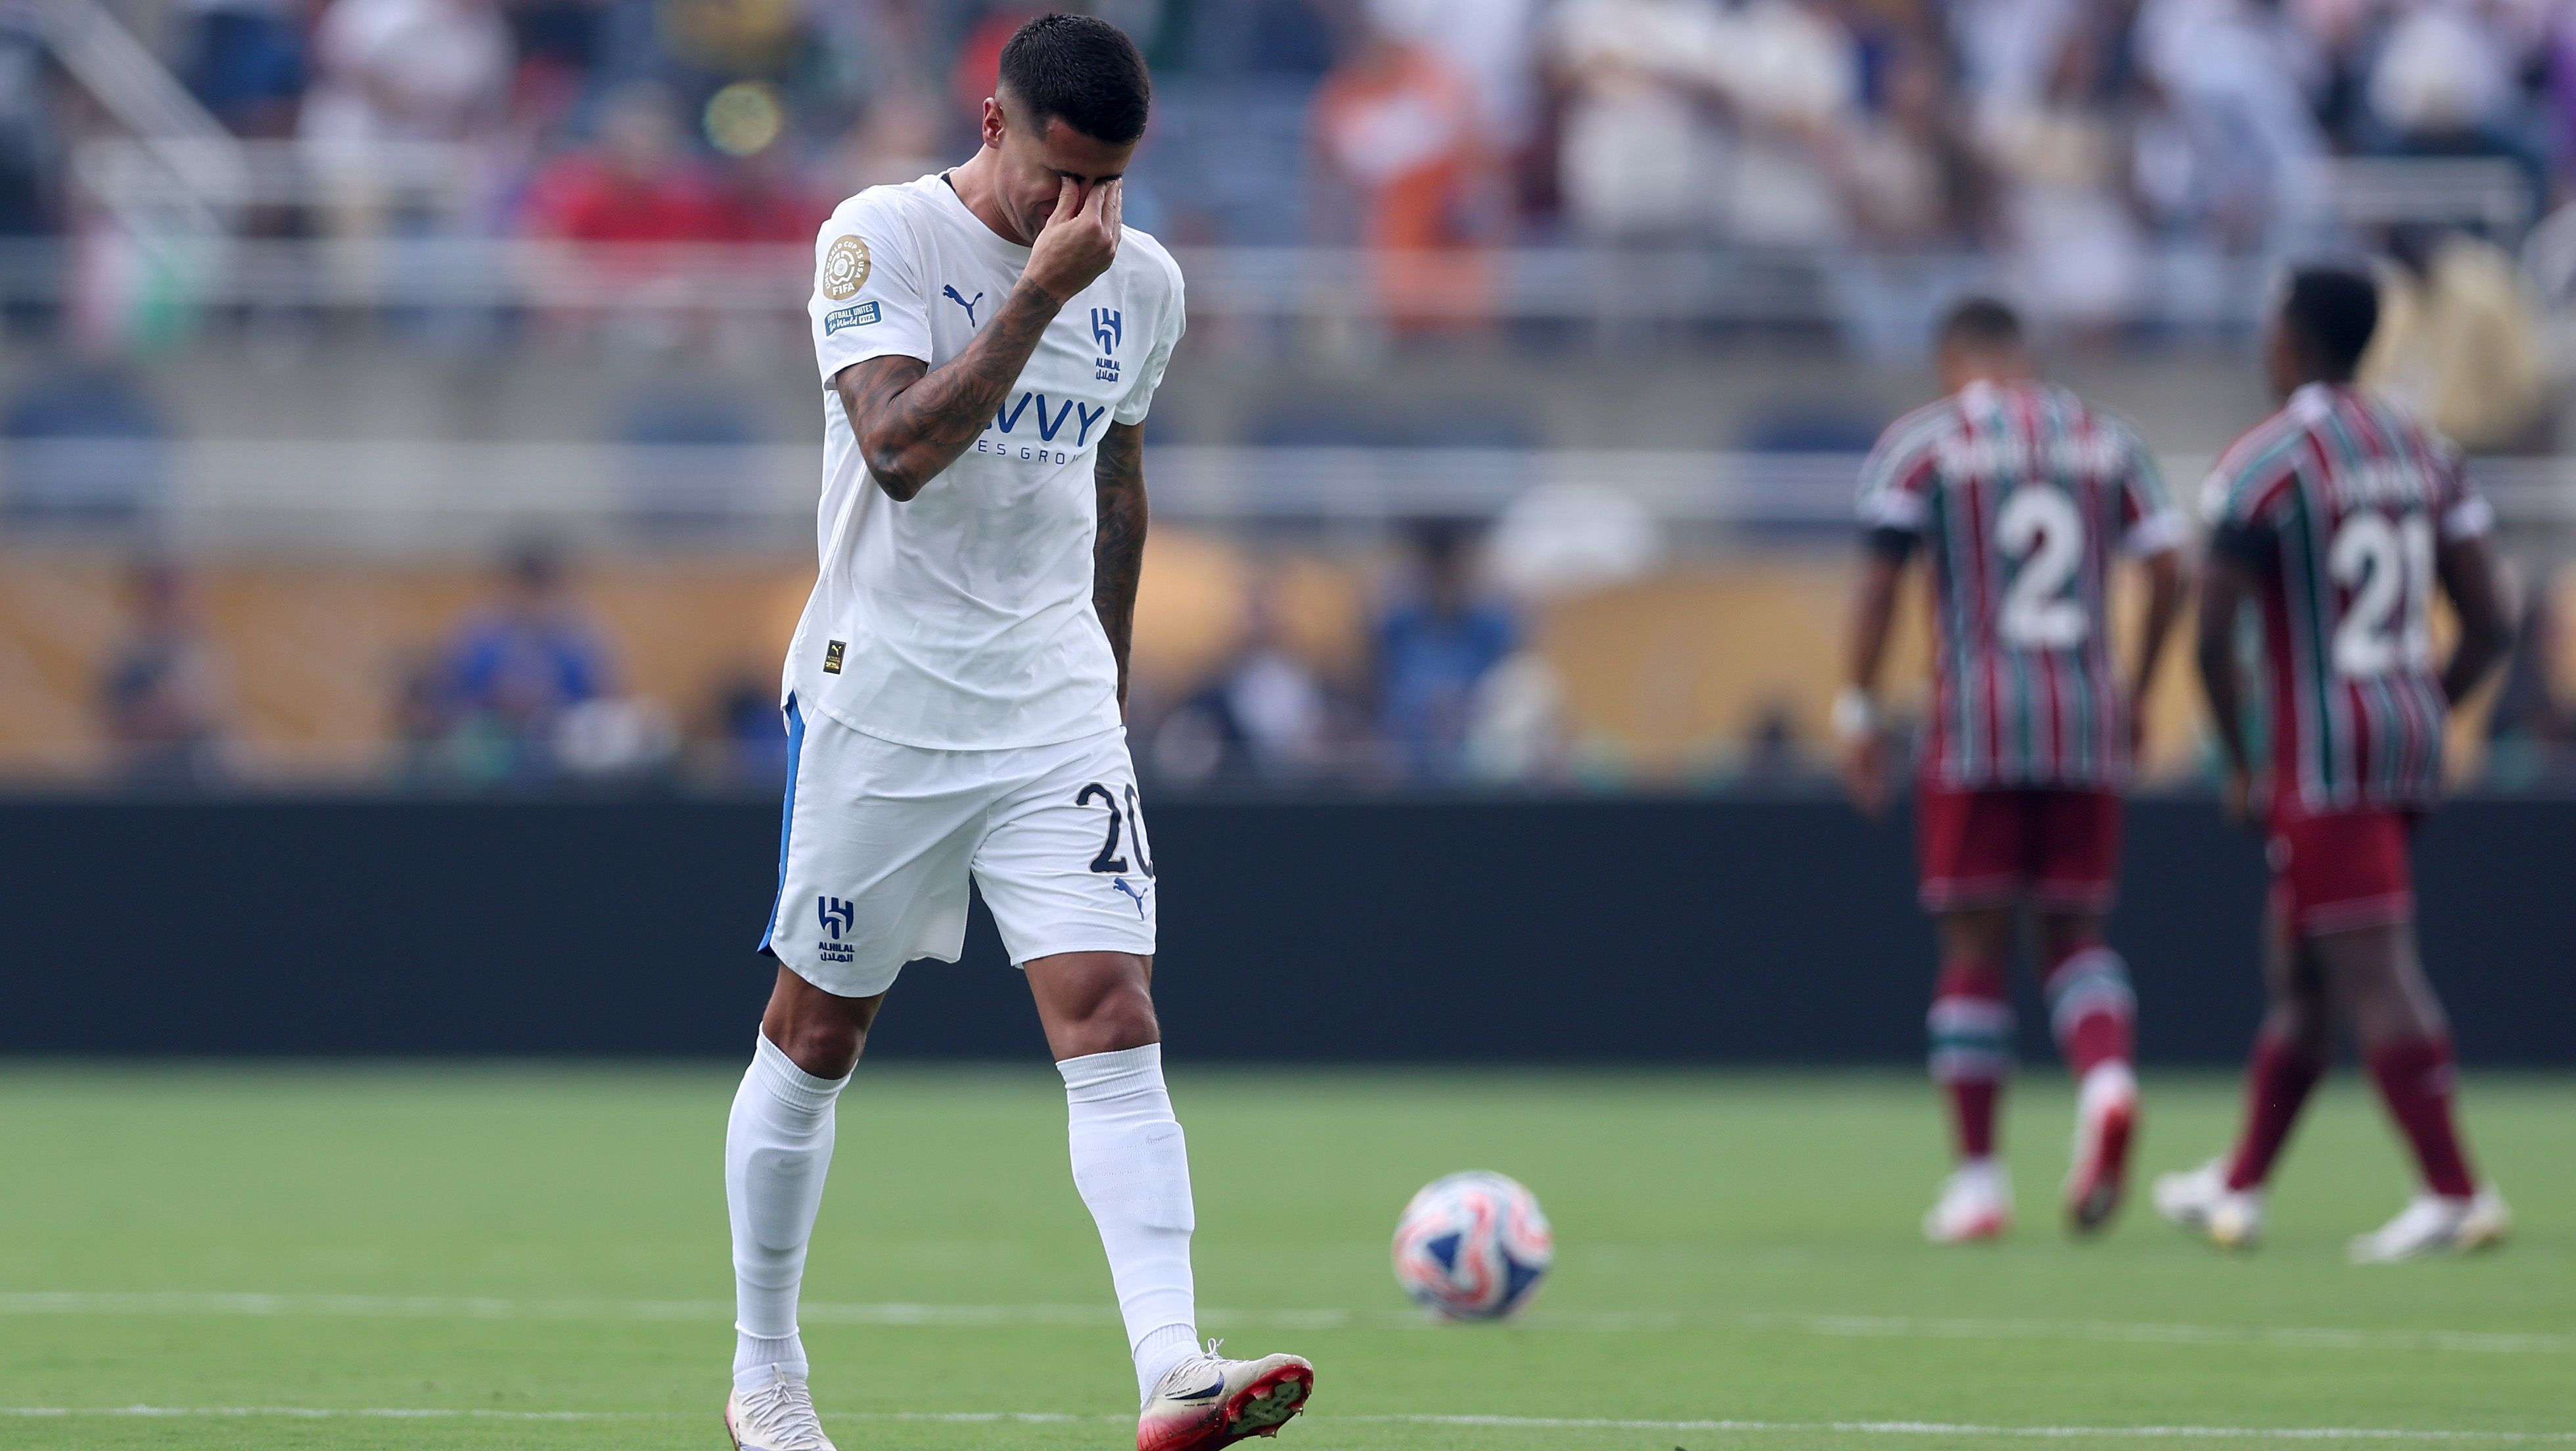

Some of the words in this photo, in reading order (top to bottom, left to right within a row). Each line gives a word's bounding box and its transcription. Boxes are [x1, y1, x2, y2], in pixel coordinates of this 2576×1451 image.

[844, 241, 858, 249] CUP
[856, 249, 863, 259] 25
[855, 261, 865, 278] USA
[833, 282, 855, 296] FIFA
[853, 304, 873, 315] UNITES
[985, 392, 1105, 448] VVY
[1994, 484, 2090, 649] 2
[2330, 512, 2439, 677] 21
[818, 941, 855, 953] ALHILAL
